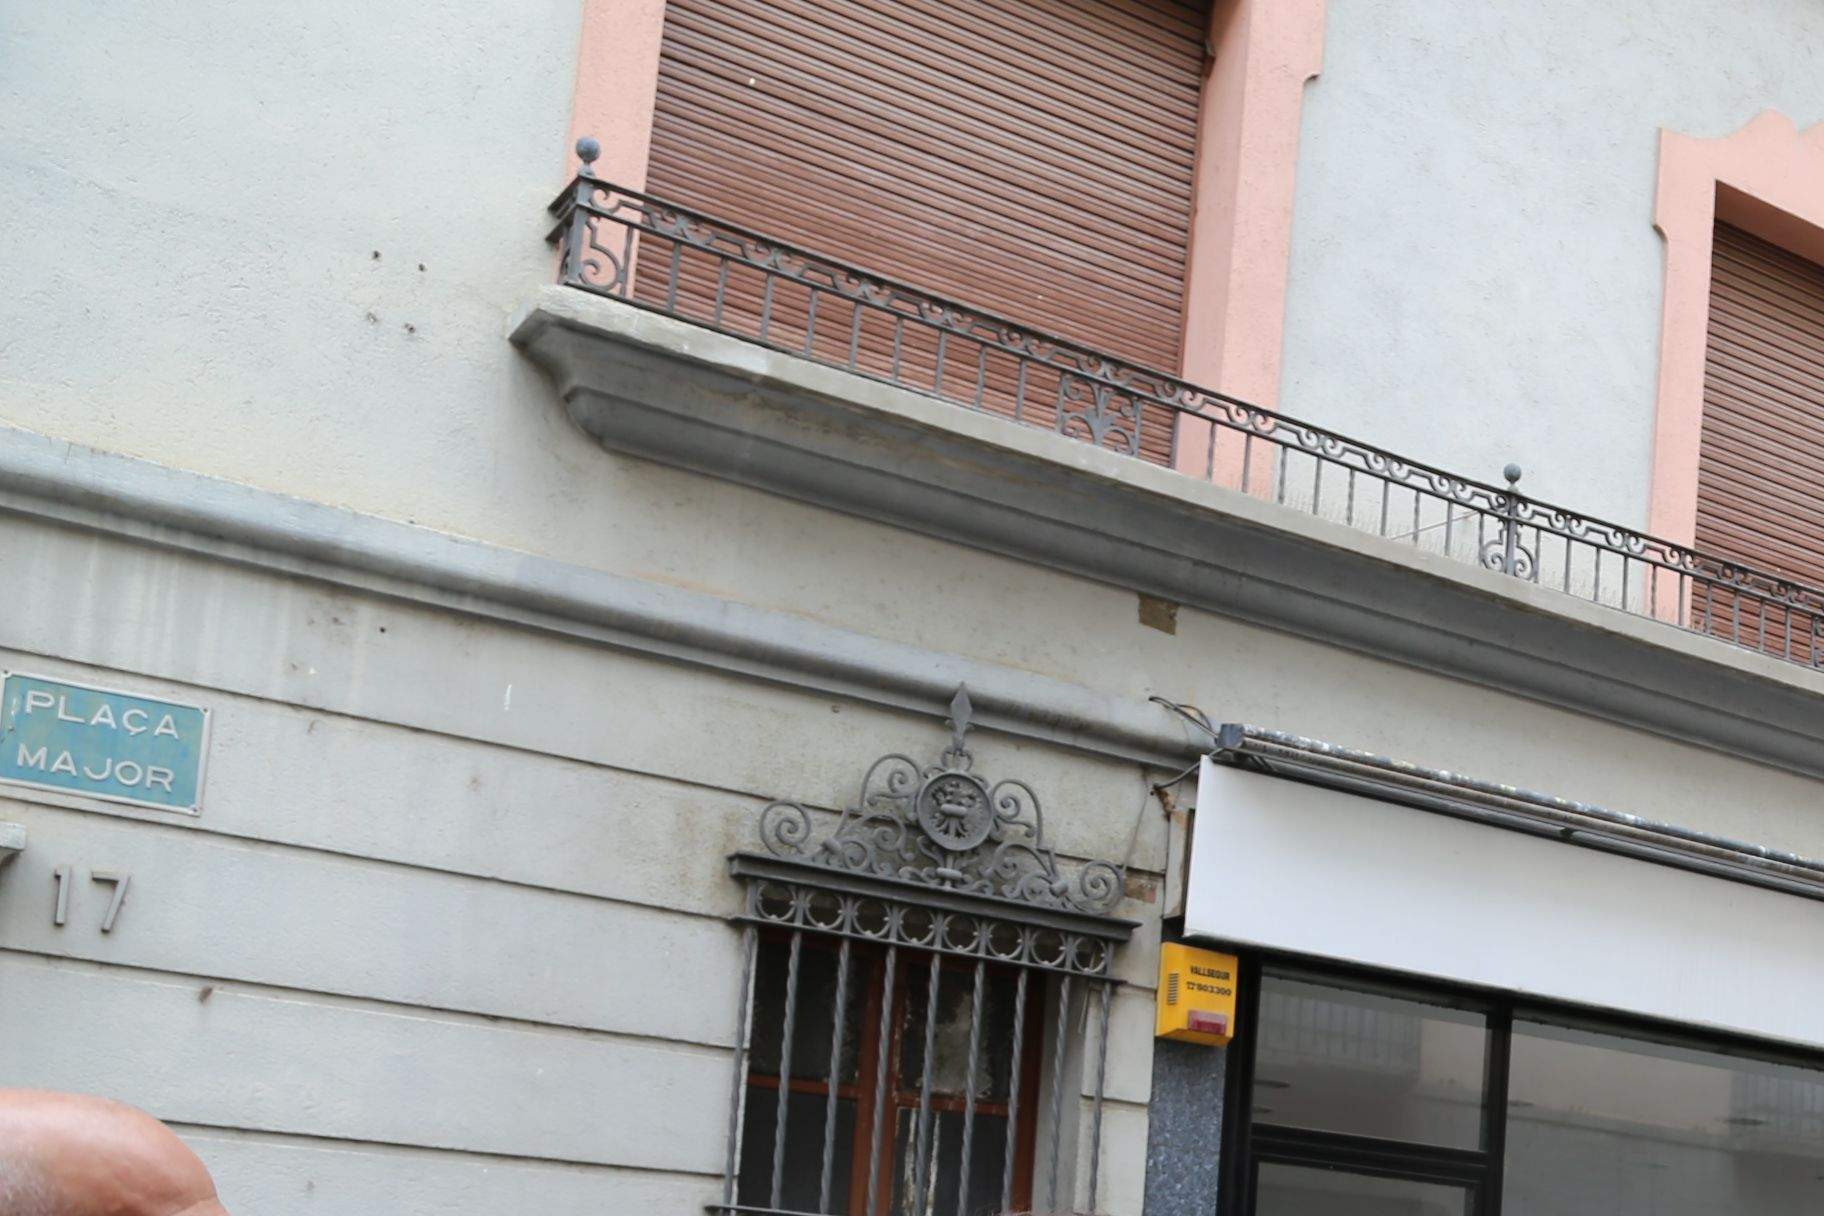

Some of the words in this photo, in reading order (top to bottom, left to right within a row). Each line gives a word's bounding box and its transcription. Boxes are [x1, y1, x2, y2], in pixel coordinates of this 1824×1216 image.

[25, 690, 180, 740] PLAÇA
[16, 742, 175, 793] MAJOR
[54, 865, 132, 934] 17
